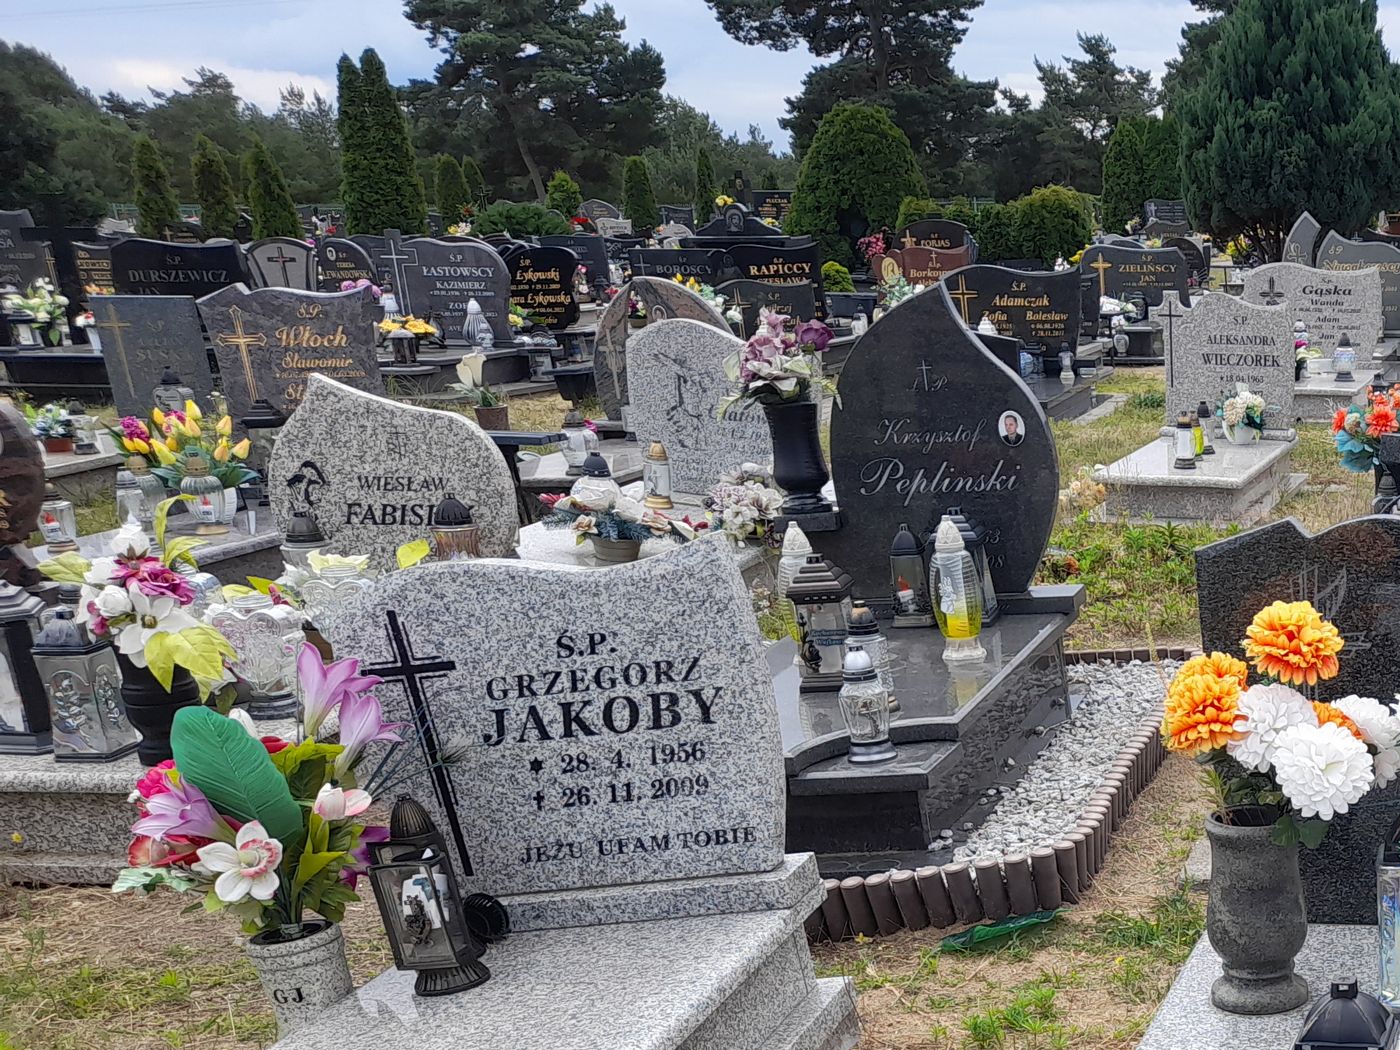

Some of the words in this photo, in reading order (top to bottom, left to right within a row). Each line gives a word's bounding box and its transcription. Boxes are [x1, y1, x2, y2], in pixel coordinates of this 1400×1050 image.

[323, 270, 373, 279] LEWANDOWSKA
[422, 266, 495, 277] ŁASTOWSCY
[656, 264, 712, 275] BOROSCY
[749, 263, 812, 276] RAPICCY
[1118, 262, 1177, 273] ZIELIŃSCY
[128, 269, 230, 283] DURSZEWICZ
[516, 268, 560, 283] Łykowski
[1139, 274, 1156, 283] JAN
[436, 281, 487, 290] KAZIMIERZ
[1302, 285, 1353, 297] Gąska
[992, 294, 1050, 307] Adamczak
[1310, 299, 1345, 307] Wanda
[1025, 310, 1069, 322] Bolesław
[275, 325, 349, 348] Włoch
[1206, 334, 1276, 346] ALEKSANDRA
[281, 351, 353, 368] Sławomir
[1201, 353, 1282, 368] WIECZOREK
[873, 418, 987, 454] Krzysztof
[357, 475, 450, 493] WIESŁAW
[344, 502, 437, 527] FABISI
[556, 629, 618, 660] Ś.P.
[486, 656, 701, 701] GRZEGORZ
[483, 686, 724, 747] JAKOBY
[561, 751, 597, 775] 28.
[610, 748, 632, 769] 4.
[648, 740, 707, 767] 1956
[562, 786, 597, 809] 26.
[606, 781, 643, 805] 11.
[651, 773, 710, 802] 2009
[520, 843, 585, 866] JEZU
[600, 833, 671, 857] UFAM
[677, 825, 757, 850] TOBIE
